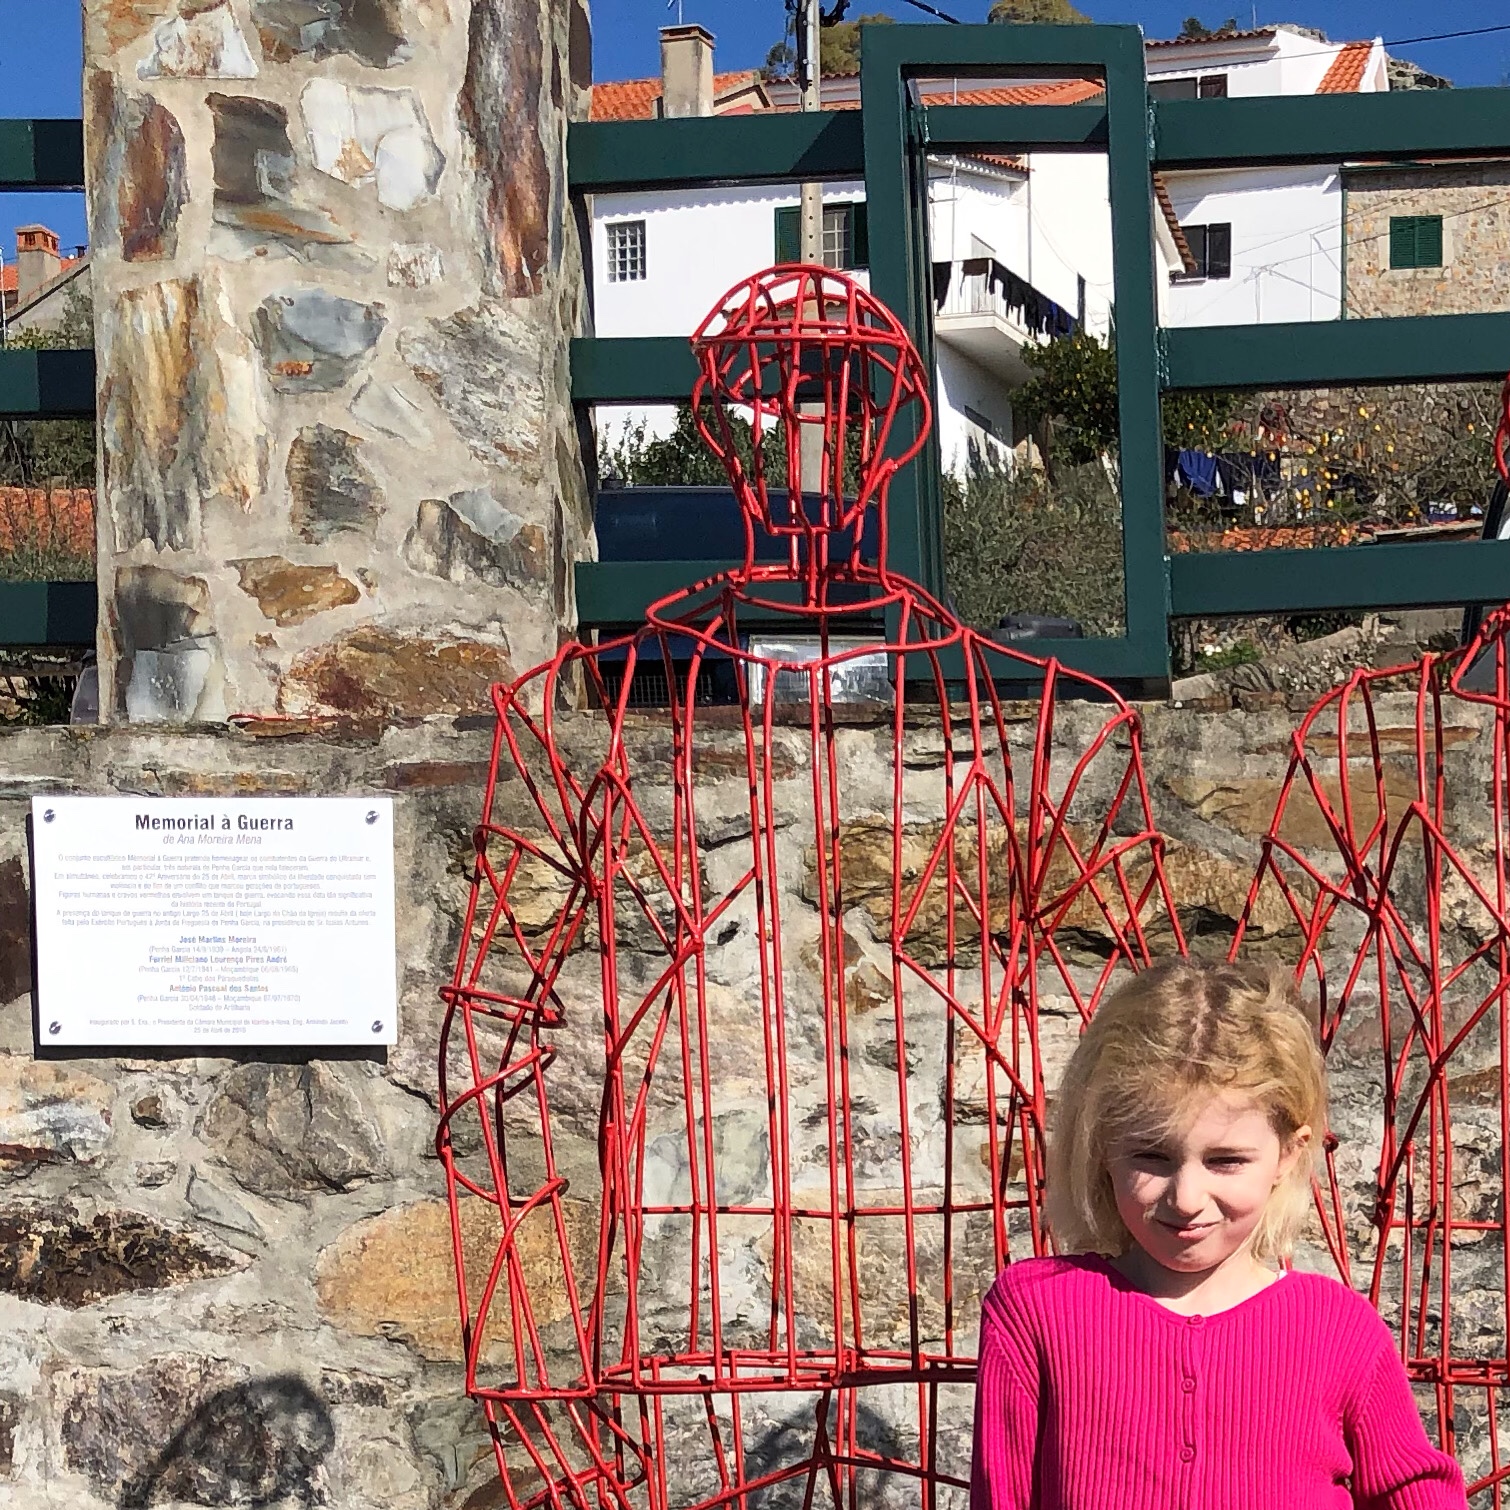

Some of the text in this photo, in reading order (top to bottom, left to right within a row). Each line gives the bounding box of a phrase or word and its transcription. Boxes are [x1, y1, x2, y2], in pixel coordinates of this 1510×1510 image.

[136, 813, 293, 831] Memorial à Guerra
[163, 834, 262, 845] de Ana Moreira Mena
